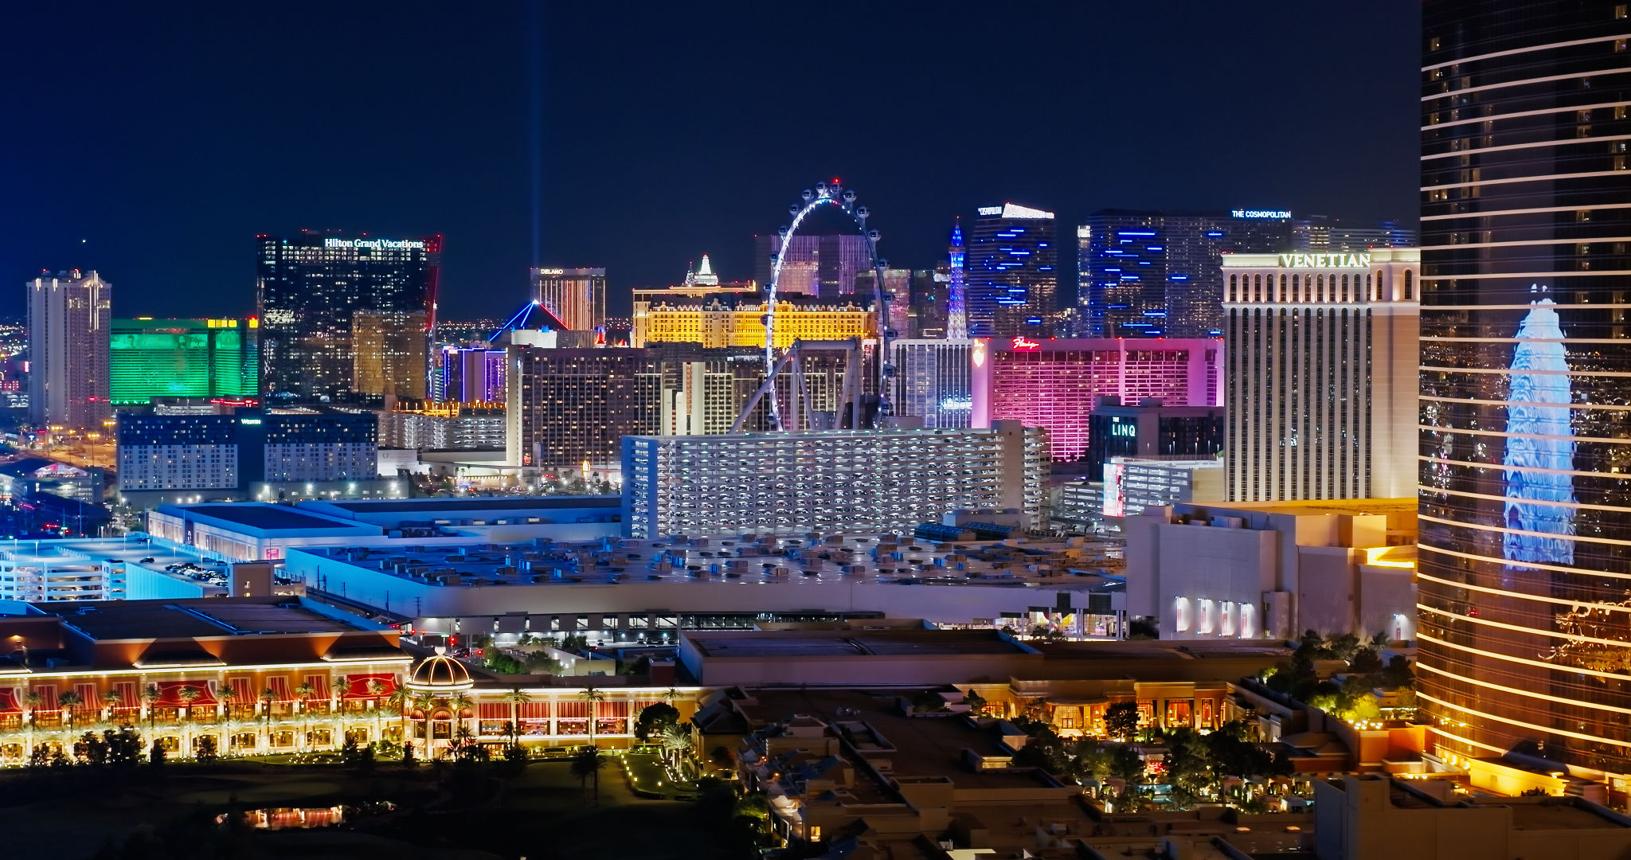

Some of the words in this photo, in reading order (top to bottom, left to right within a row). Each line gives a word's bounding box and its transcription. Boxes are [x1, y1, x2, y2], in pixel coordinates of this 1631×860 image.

[1232, 210, 1244, 218] THE
[1245, 210, 1291, 219] COSMOPOLITAN
[324, 238, 353, 248] Hilton
[353, 239, 380, 248] Grand
[381, 239, 423, 249] Vacations
[1280, 253, 1371, 268] VENETIAN
[1112, 423, 1136, 437] LINQ
